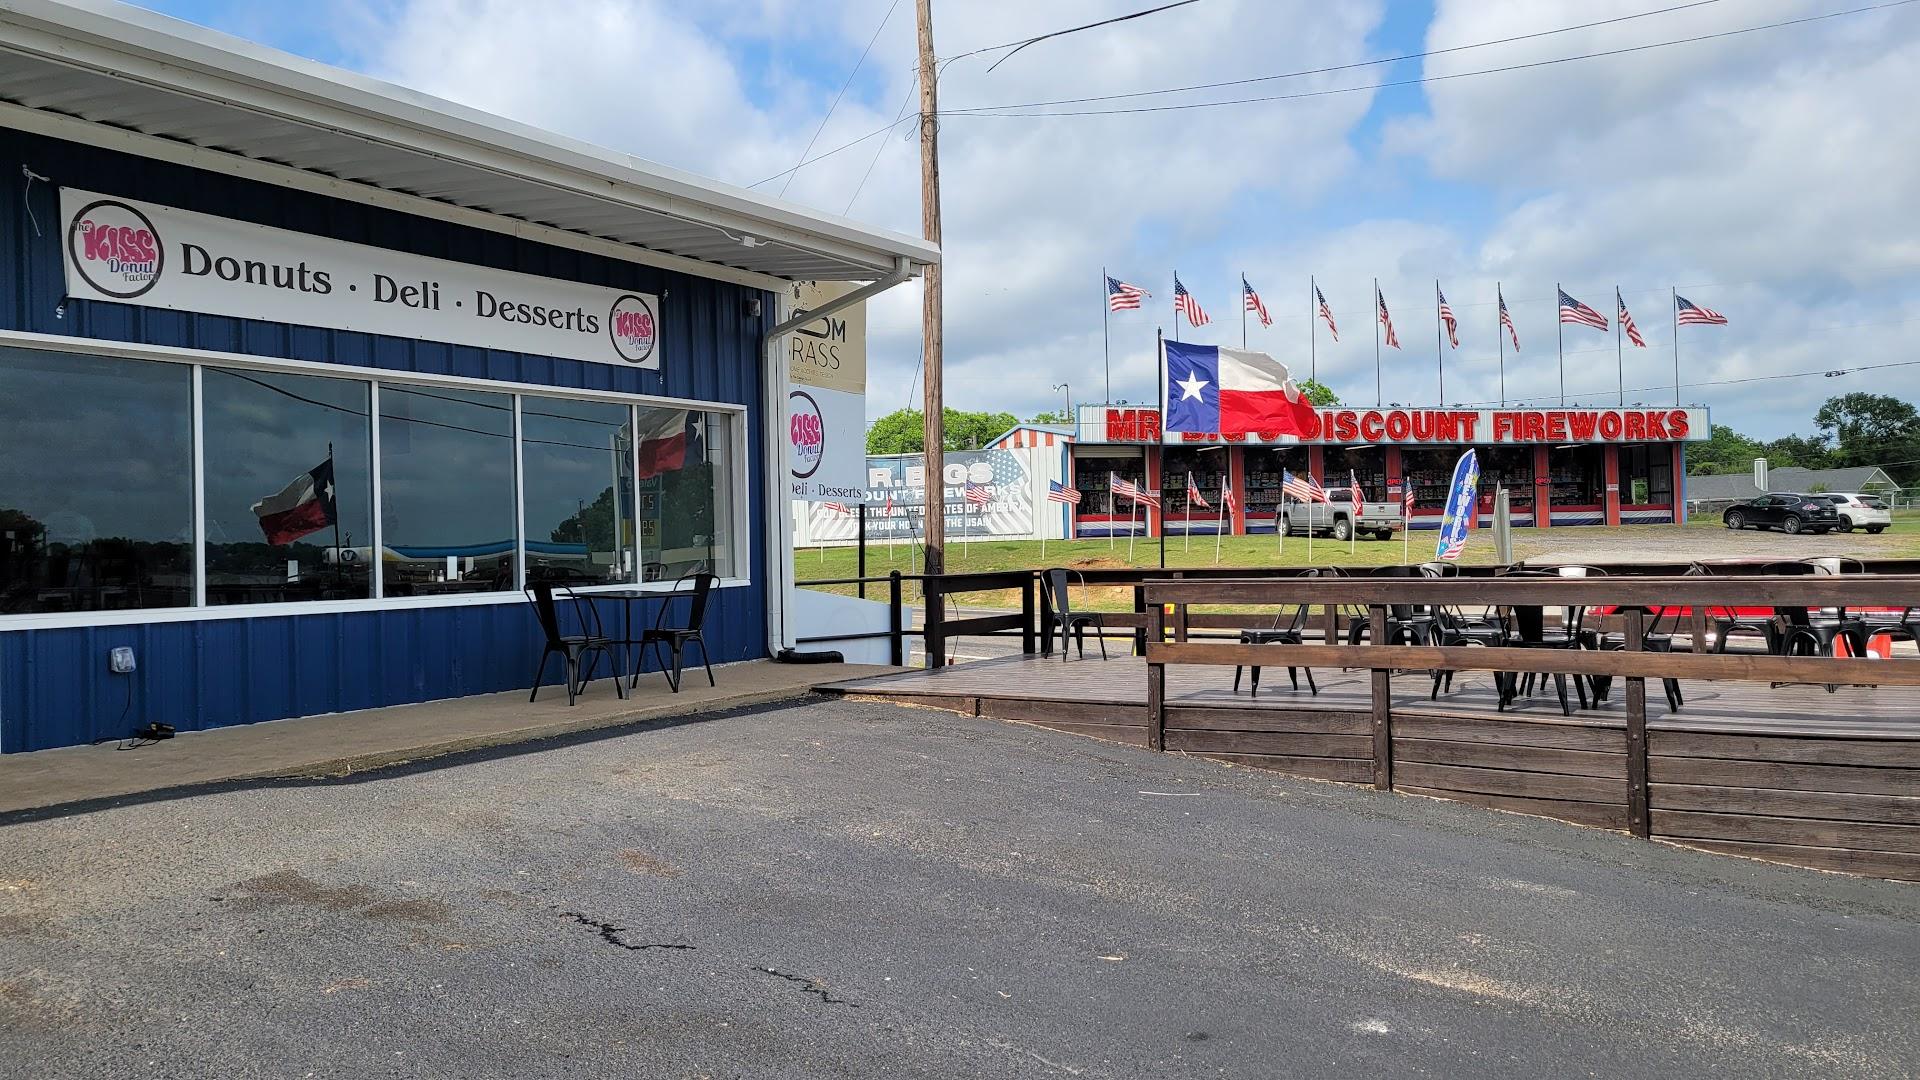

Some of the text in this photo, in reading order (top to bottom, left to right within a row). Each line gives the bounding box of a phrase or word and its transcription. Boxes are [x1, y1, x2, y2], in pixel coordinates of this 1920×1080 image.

[82, 219, 156, 263] KISS
[107, 258, 155, 274] Donut
[180, 242, 600, 334] Donuts Deli Desserts
[616, 311, 652, 338] KISS
[789, 336, 840, 370] RASS
[1493, 410, 1689, 441] FIREWORKS
[818, 483, 862, 499] Desserts
[870, 506, 888, 518] THE
[966, 503, 979, 514] OF
[898, 519, 924, 530] HON
[946, 518, 963, 529] THE
